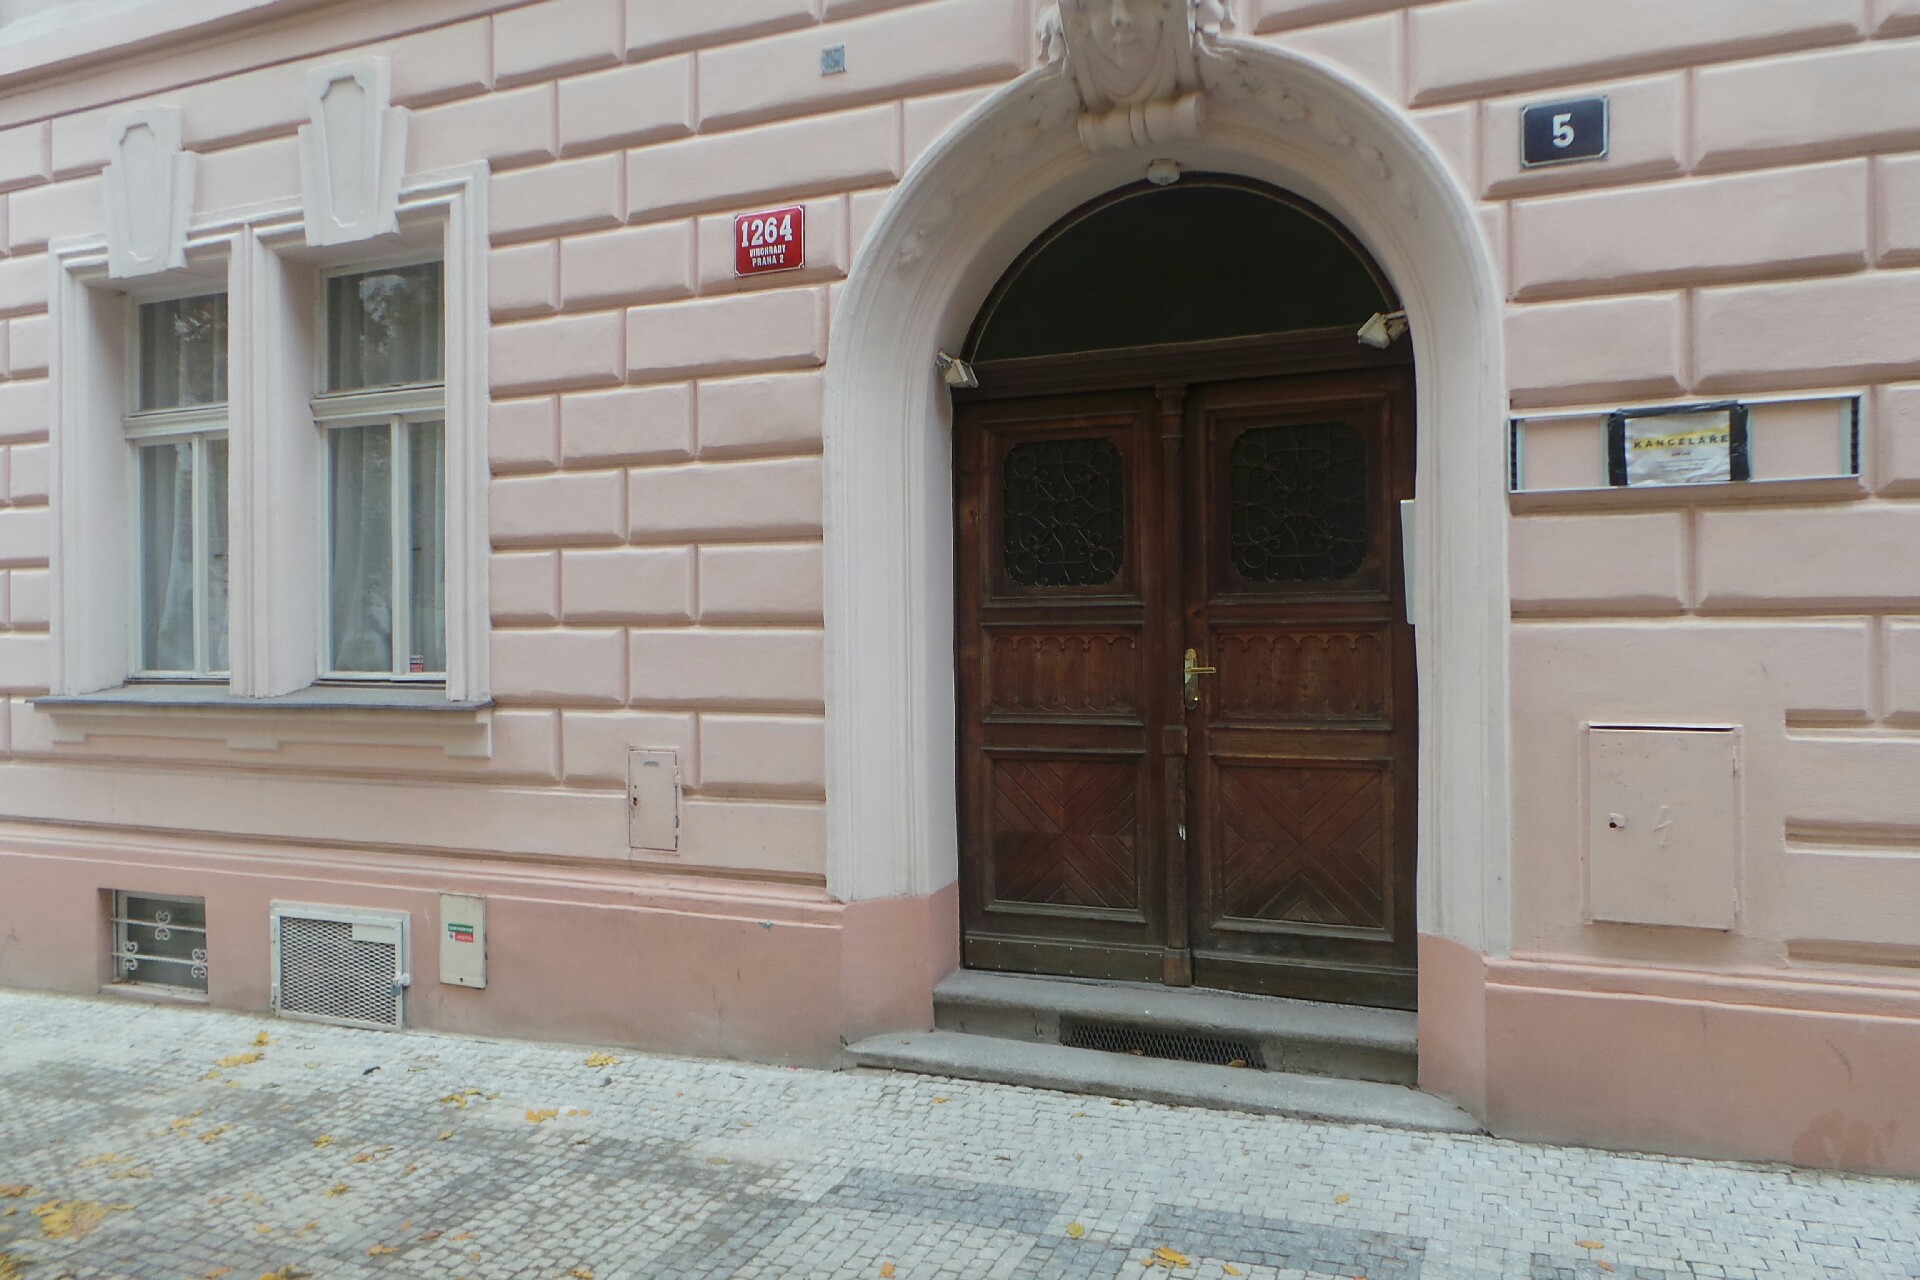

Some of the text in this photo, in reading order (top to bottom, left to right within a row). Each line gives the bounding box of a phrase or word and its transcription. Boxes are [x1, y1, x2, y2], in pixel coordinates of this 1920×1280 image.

[1552, 112, 1575, 149] 5
[741, 214, 793, 248] 1264
[749, 244, 786, 258] VINOHRADY
[751, 254, 784, 268] PRAHA 2
